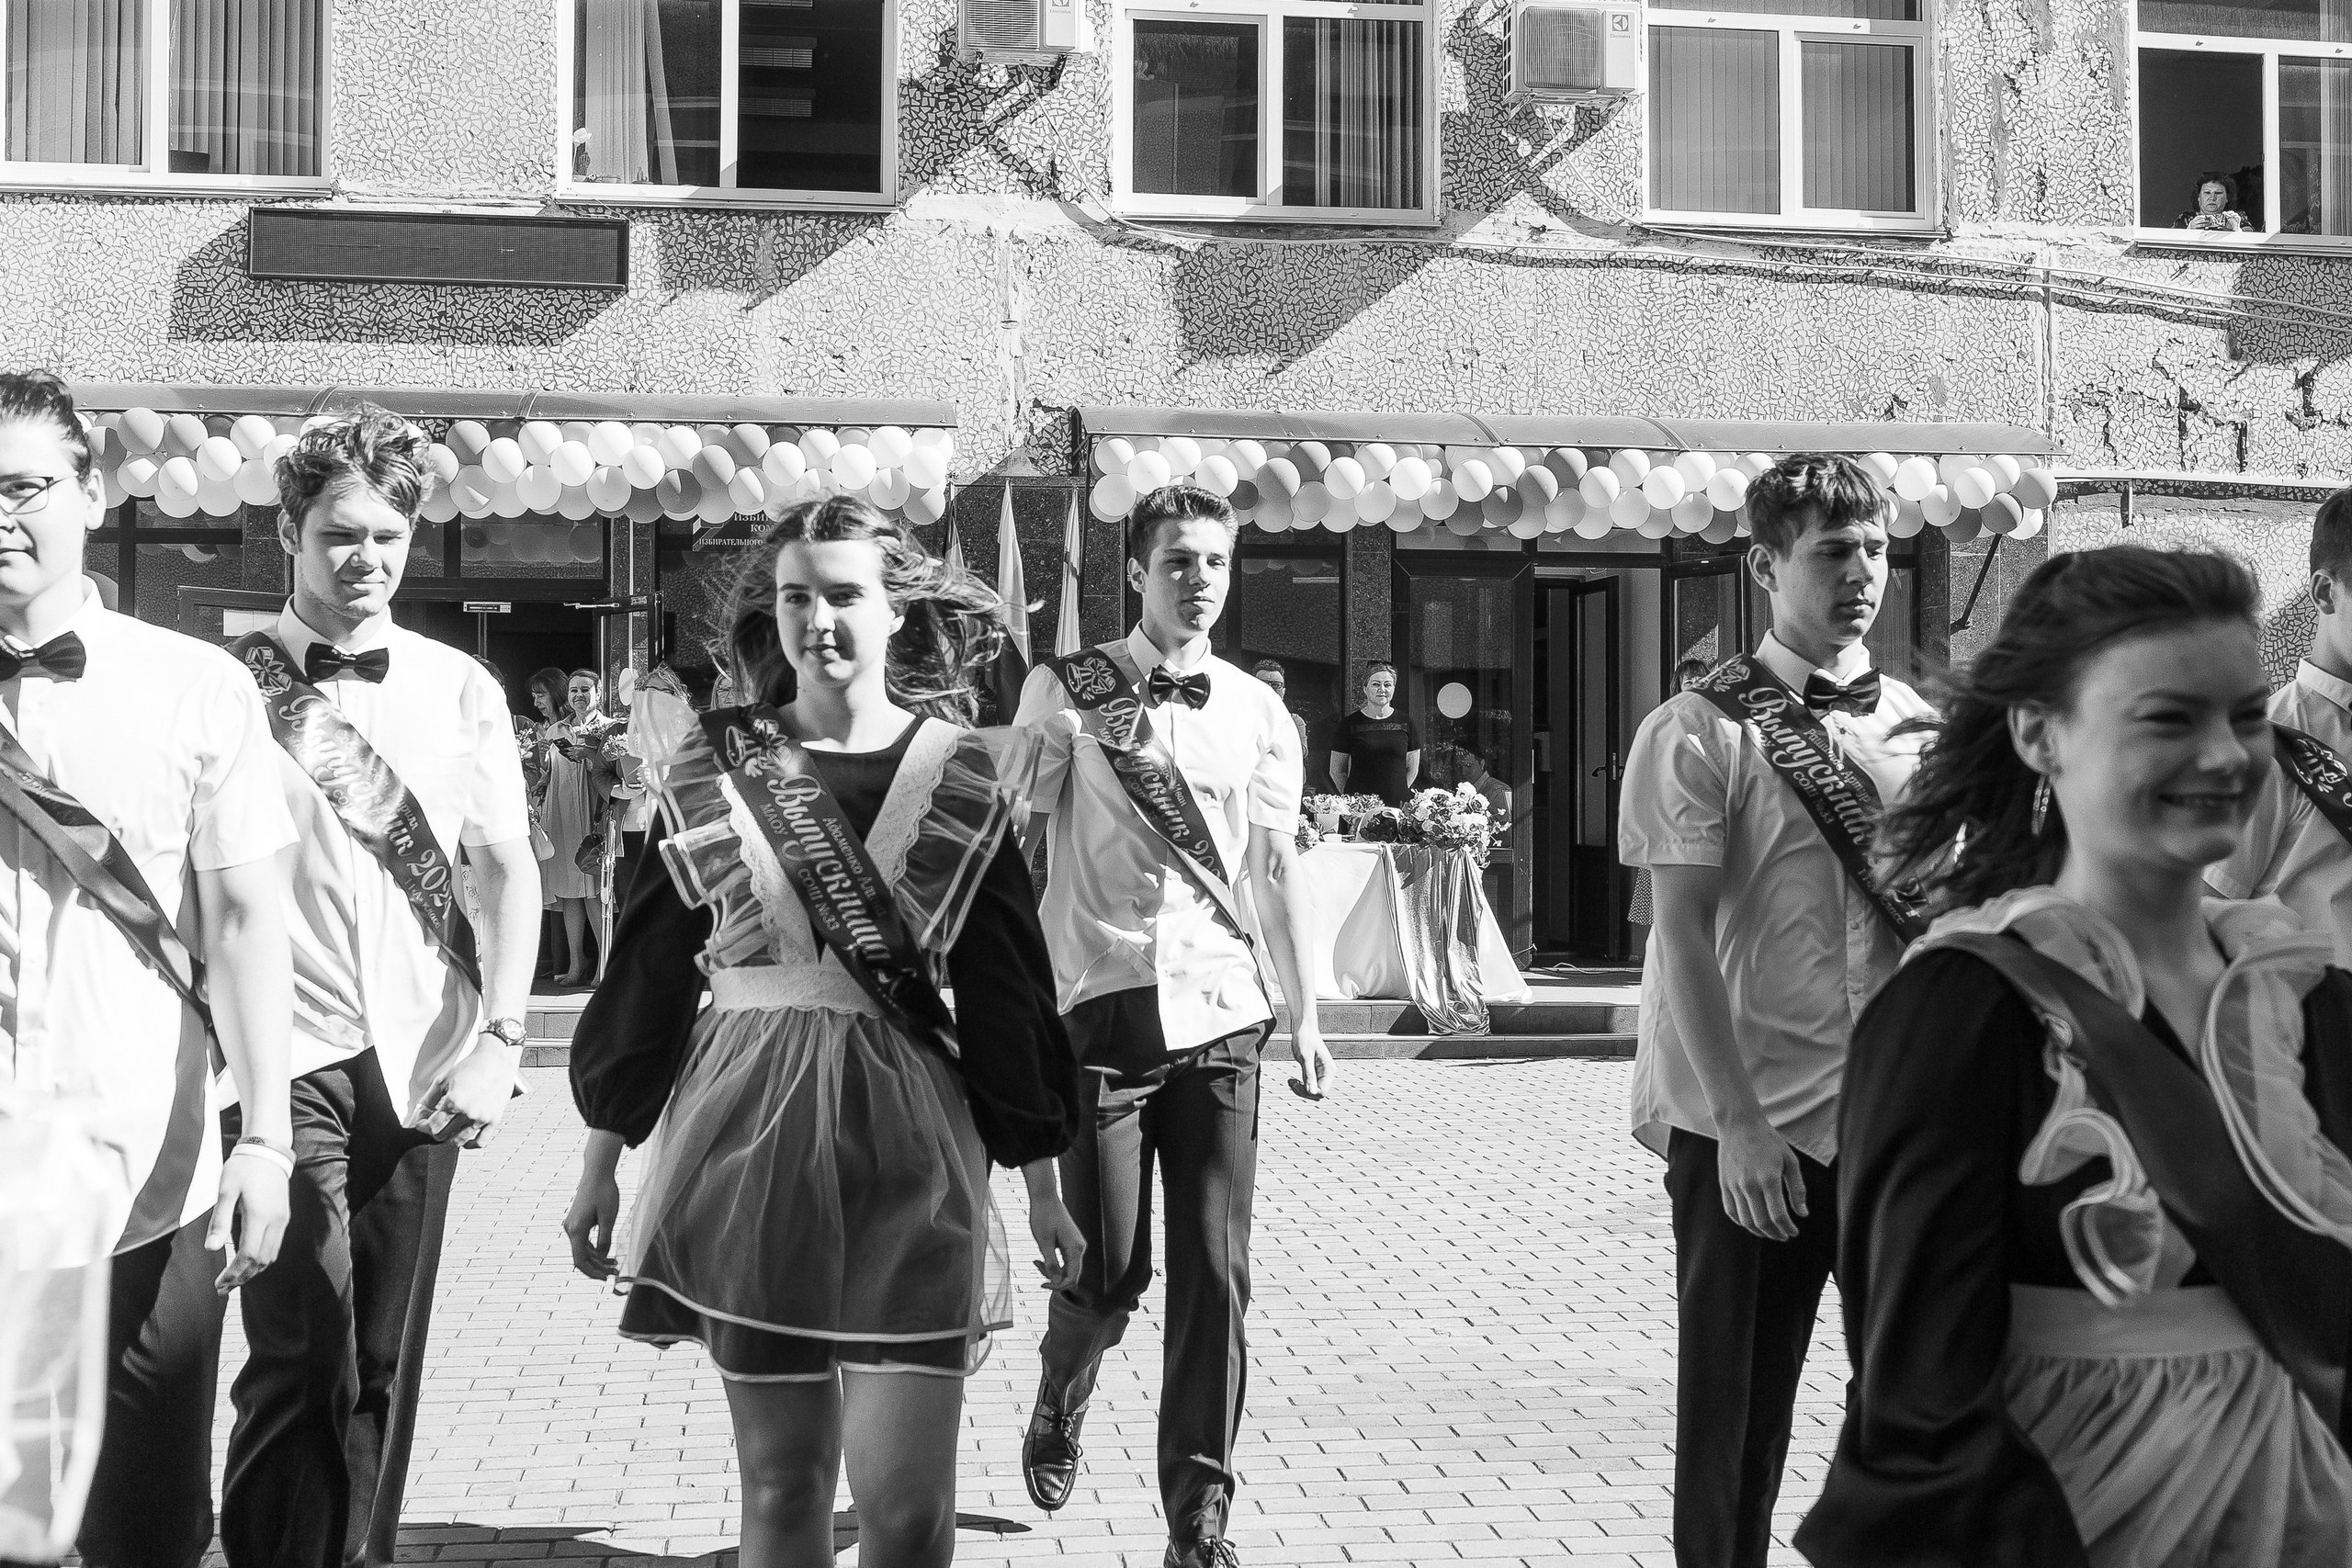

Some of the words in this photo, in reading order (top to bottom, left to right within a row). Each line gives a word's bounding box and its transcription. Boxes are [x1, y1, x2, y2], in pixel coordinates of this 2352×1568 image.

[1097, 727, 1119, 751] МАО
[1792, 771, 1820, 798] СОШ
[760, 803, 788, 836] МАОУ
[822, 818, 864, 874] Адаменко
[766, 773, 891, 961] Выпускница
[797, 868, 824, 901] СОШ
